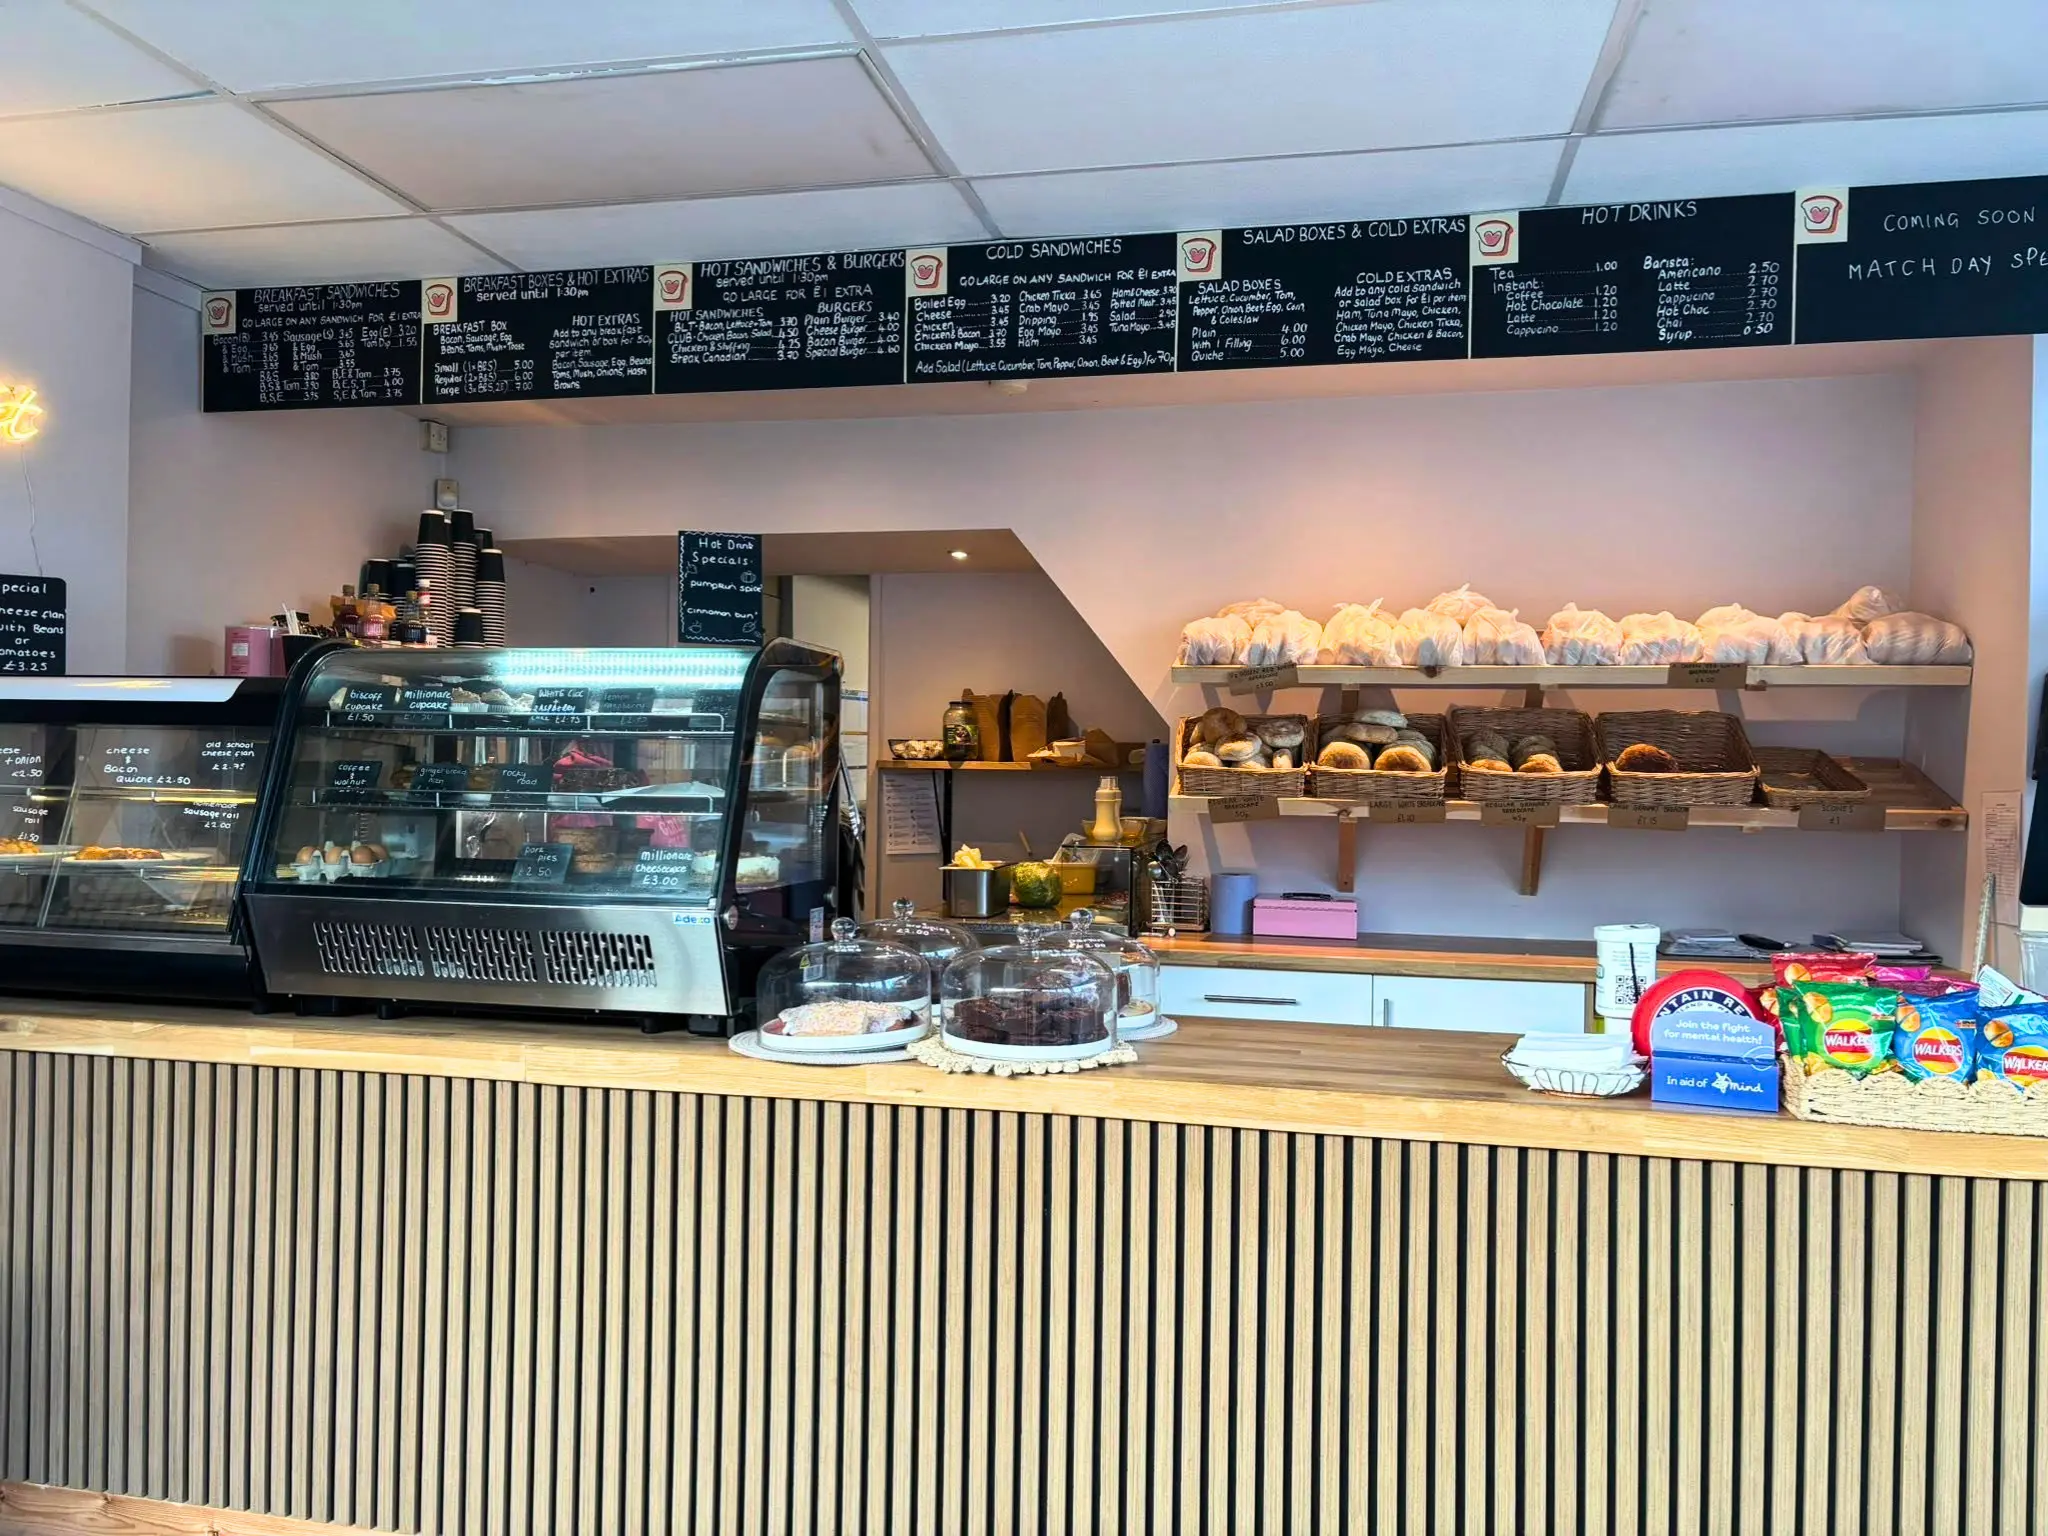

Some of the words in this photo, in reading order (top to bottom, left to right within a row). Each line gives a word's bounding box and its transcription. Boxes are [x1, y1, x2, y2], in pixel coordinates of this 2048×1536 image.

[1582, 206, 1624, 225] HOT
[1629, 201, 1697, 221] DRINKS
[1884, 213, 1959, 232] COMING
[1977, 207, 2035, 225] SOON
[1243, 227, 1295, 245] SALAD
[1300, 224, 1345, 242] BOXES
[1352, 223, 1362, 238] &
[1368, 220, 1407, 237] COLD
[1413, 219, 1465, 235] EXTRAS
[987, 243, 1024, 259] COLD
[1030, 239, 1122, 258] SANDWICHES
[700, 262, 731, 277] HOT
[734, 256, 821, 275] SANDWICHES
[827, 256, 836, 268] &
[843, 252, 904, 268] BURGERS
[1643, 256, 1694, 270] Barista:
[1848, 258, 1936, 280] MATCH
[1950, 255, 1991, 275] DAY
[1356, 271, 1393, 284] COLD
[1397, 267, 1452, 282] EXTRAS
[1490, 267, 1515, 280] Tea
[1596, 261, 1618, 272] 1.00
[1658, 265, 1721, 280] Americano
[1749, 262, 1780, 274] 2.50
[464, 275, 525, 292] BREAKFAST
[529, 273, 563, 288] BOXES
[567, 274, 575, 285] &
[578, 270, 600, 285] HOT
[604, 268, 649, 284] EXTRAS
[716, 275, 753, 288] served
[759, 273, 784, 284] until
[793, 273, 828, 283] 1:30pm
[1198, 281, 1240, 294] SALAD
[1243, 278, 1281, 291] BOXES
[1658, 280, 1690, 292] Latte
[1748, 275, 1778, 286] 2.70
[254, 287, 322, 304] BREAKFAST
[327, 283, 399, 300] SANDWICHES
[477, 290, 517, 301] served
[521, 288, 548, 299] until
[557, 287, 588, 298] 1:30pm
[723, 292, 737, 302] GO
[741, 290, 778, 301] LARGE
[786, 289, 806, 299] FOR
[836, 284, 873, 297] EXTRA
[1506, 291, 1544, 300] Coffee
[1596, 285, 1617, 295] 1.20
[1748, 287, 1777, 298] 2.70
[258, 303, 294, 313] served
[300, 301, 324, 311] until
[333, 300, 362, 310] 1:30pm
[817, 301, 873, 314] BURGERS
[915, 297, 946, 310] Boiled
[948, 297, 966, 310] Egg
[991, 293, 1011, 303] 3.20
[1506, 301, 1527, 311] Hot
[1531, 298, 1583, 310] Chocolate
[1594, 298, 1617, 308] 1.20
[1657, 305, 1679, 316] Hot
[1683, 305, 1709, 315] Choc
[1747, 299, 1776, 310] 2.70
[573, 315, 593, 326] HOT
[598, 313, 640, 325] EXTRAS
[670, 310, 692, 322] HOT
[696, 307, 763, 320] SANDWICHES
[804, 315, 830, 325] Plain
[834, 314, 866, 326] Burger
[878, 312, 899, 321] 3.40
[916, 309, 952, 322] Cheese
[1507, 313, 1536, 323] Latte
[1594, 310, 1617, 319] 1.20
[1657, 318, 1683, 329] Chai
[1746, 312, 1774, 322] 2.70
[433, 321, 485, 335] BREAKFAST
[491, 321, 507, 331] BOX
[1192, 328, 1217, 338] Plain
[1281, 323, 1307, 333] 4.00
[1595, 322, 1618, 331] 1.20
[1658, 330, 1692, 343] Syrup
[1191, 351, 1224, 362] Quiche
[1279, 348, 1304, 358] 5.00
[699, 538, 722, 548] Hot
[728, 540, 753, 549] Drink
[692, 551, 748, 565] Specials
[41, 611, 64, 619] flan
[33, 624, 64, 634] Beans
[3, 661, 47, 671] £3.25
[350, 690, 382, 699] biscoff
[410, 702, 447, 710] cupcake
[348, 714, 374, 722] £1.50
[15, 754, 41, 764] onion
[104, 765, 138, 773] Bacon
[502, 769, 526, 778] rocky
[157, 776, 191, 784] £2.50
[12, 805, 48, 815] sausage
[18, 832, 39, 842] £1.50
[642, 876, 678, 885] £3.00
[1676, 1020, 1698, 1028] Join
[1701, 1022, 1719, 1030] the
[1664, 1029, 1679, 1038] for
[1682, 1032, 1720, 1041] mental
[1723, 1034, 1763, 1044] health!
[1825, 1033, 1873, 1047] WALKE
[1915, 1042, 1962, 1056] WALKERS
[1667, 1076, 1677, 1085] In
[1679, 1077, 1694, 1086] aid
[1696, 1078, 1708, 1087] of
[1730, 1081, 1763, 1092] mind
